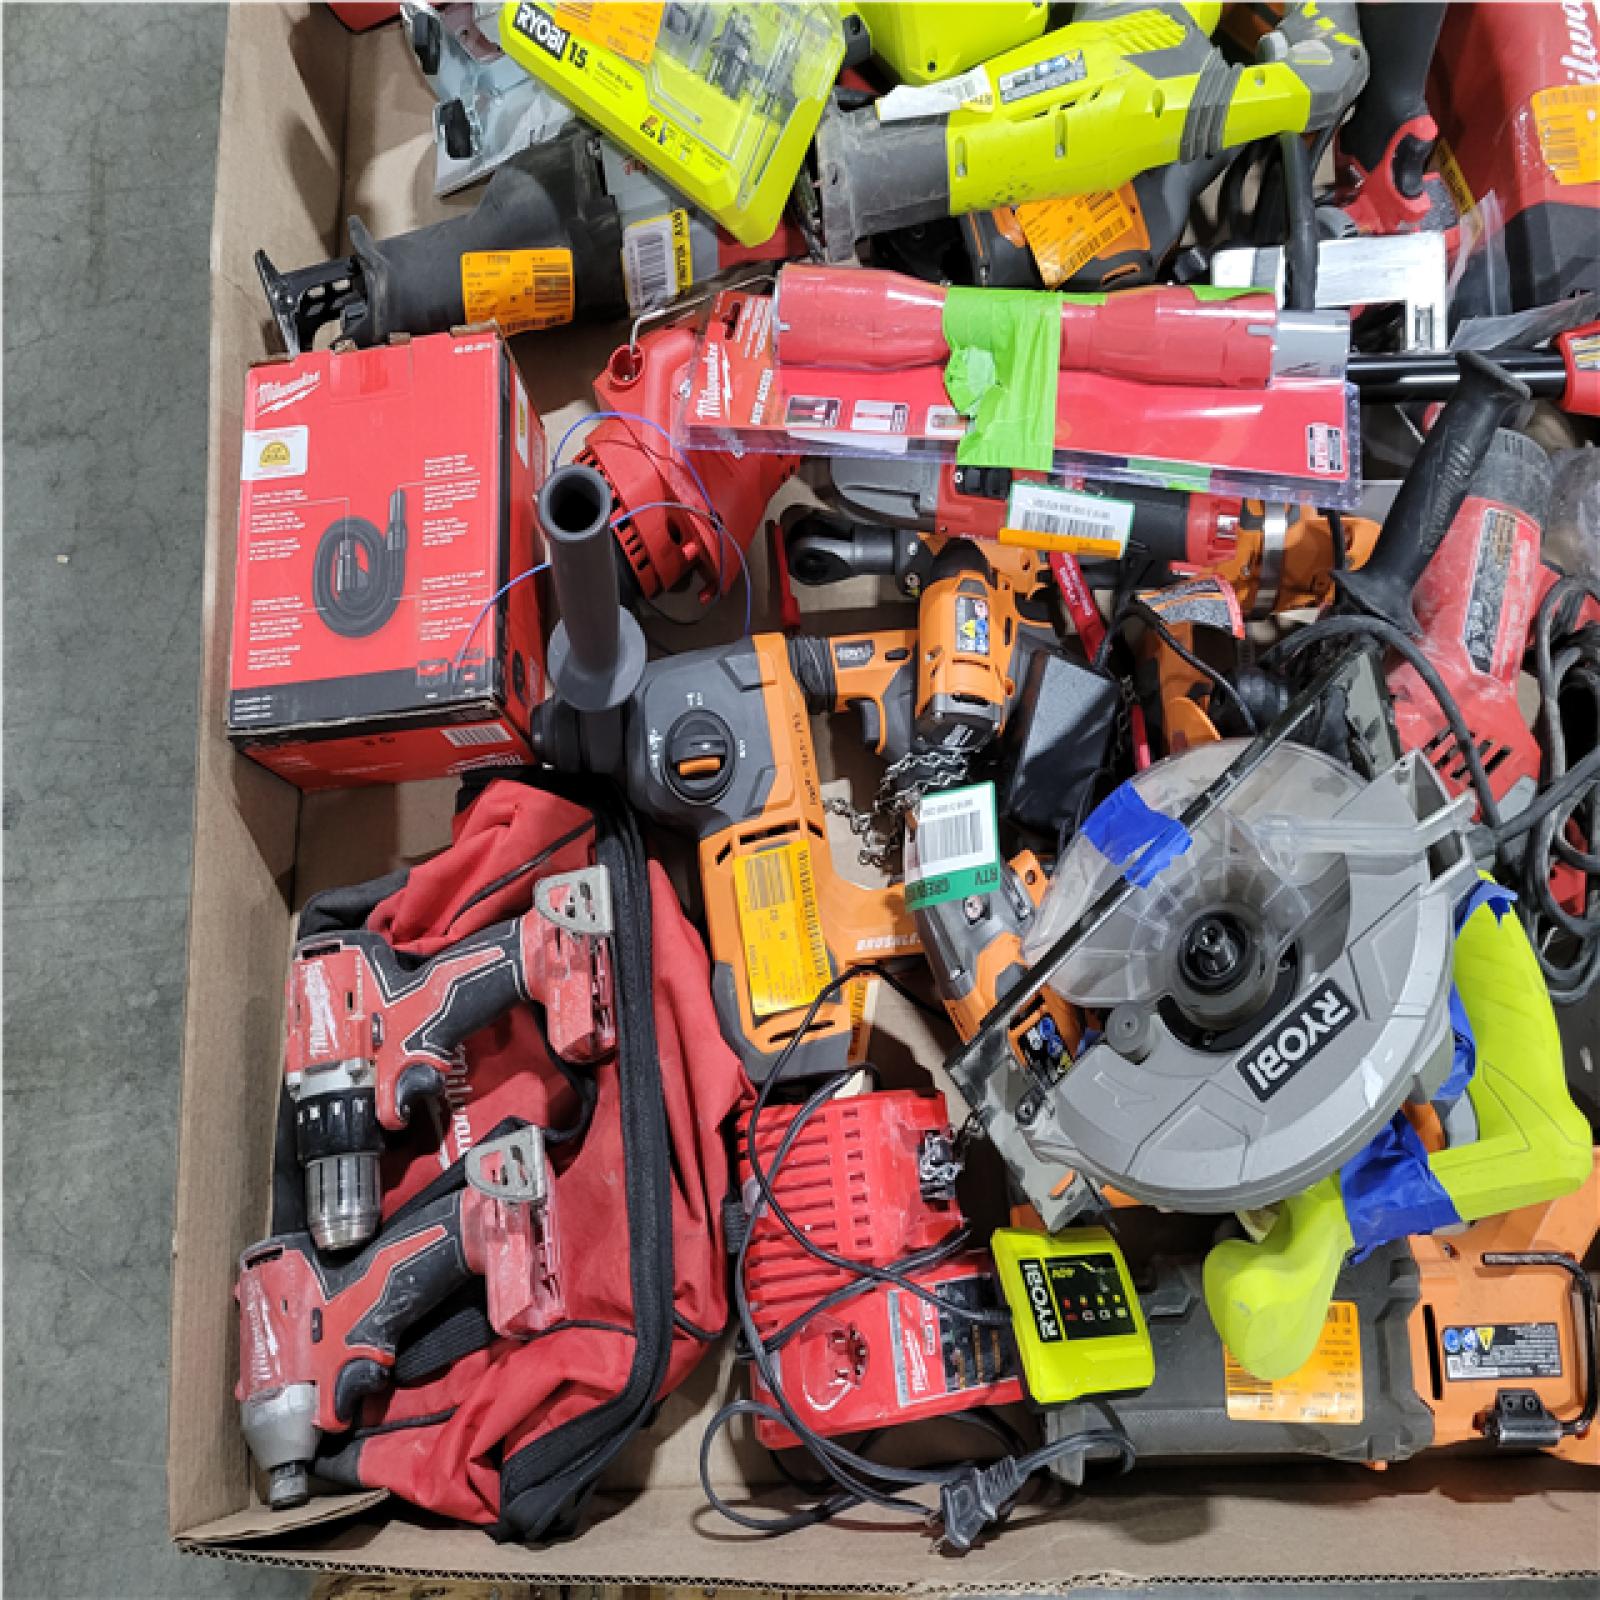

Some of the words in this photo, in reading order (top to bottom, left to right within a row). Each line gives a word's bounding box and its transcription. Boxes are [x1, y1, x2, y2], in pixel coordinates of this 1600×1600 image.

[516, 2, 567, 56] RYOBI
[569, 42, 589, 69] 15
[257, 371, 321, 406] Milwaukee
[1247, 990, 1351, 1091] RYOBI
[1024, 1263, 1061, 1342] RYOBI
